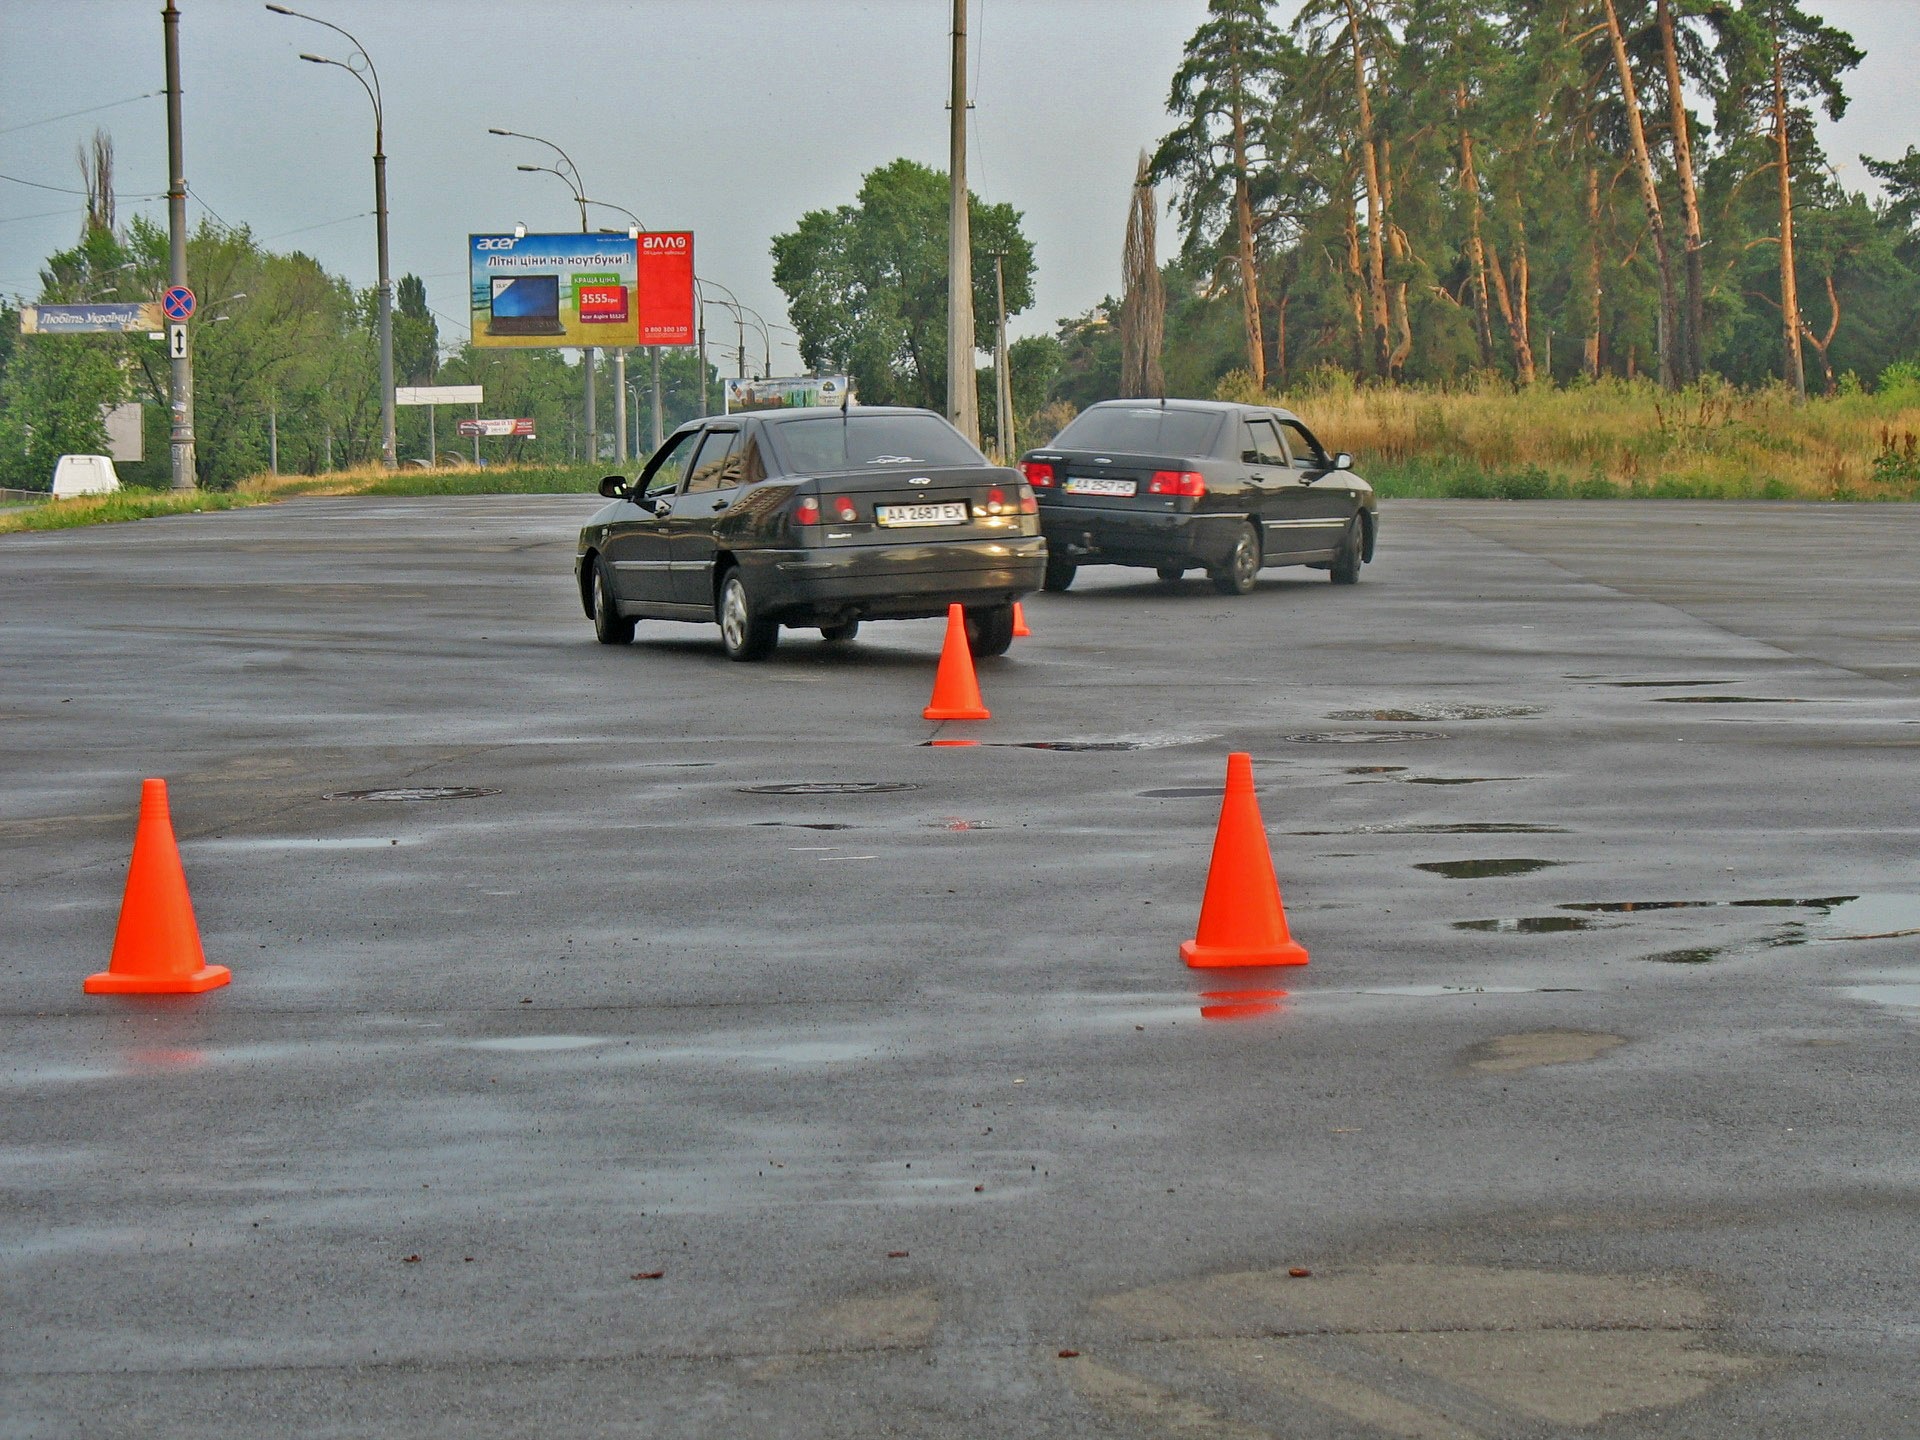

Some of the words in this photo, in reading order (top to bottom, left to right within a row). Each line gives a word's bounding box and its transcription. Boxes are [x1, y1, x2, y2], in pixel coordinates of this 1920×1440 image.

[476, 237, 519, 250] acer
[488, 255, 517, 266] Літні
[521, 254, 547, 267] ціни
[550, 256, 564, 265] на
[41, 312, 84, 324] Любіть
[85, 311, 132, 325] Україну!
[1075, 480, 1089, 488] AA
[888, 508, 906, 520] AA
[909, 506, 939, 520] 2687
[943, 505, 963, 519] EX
